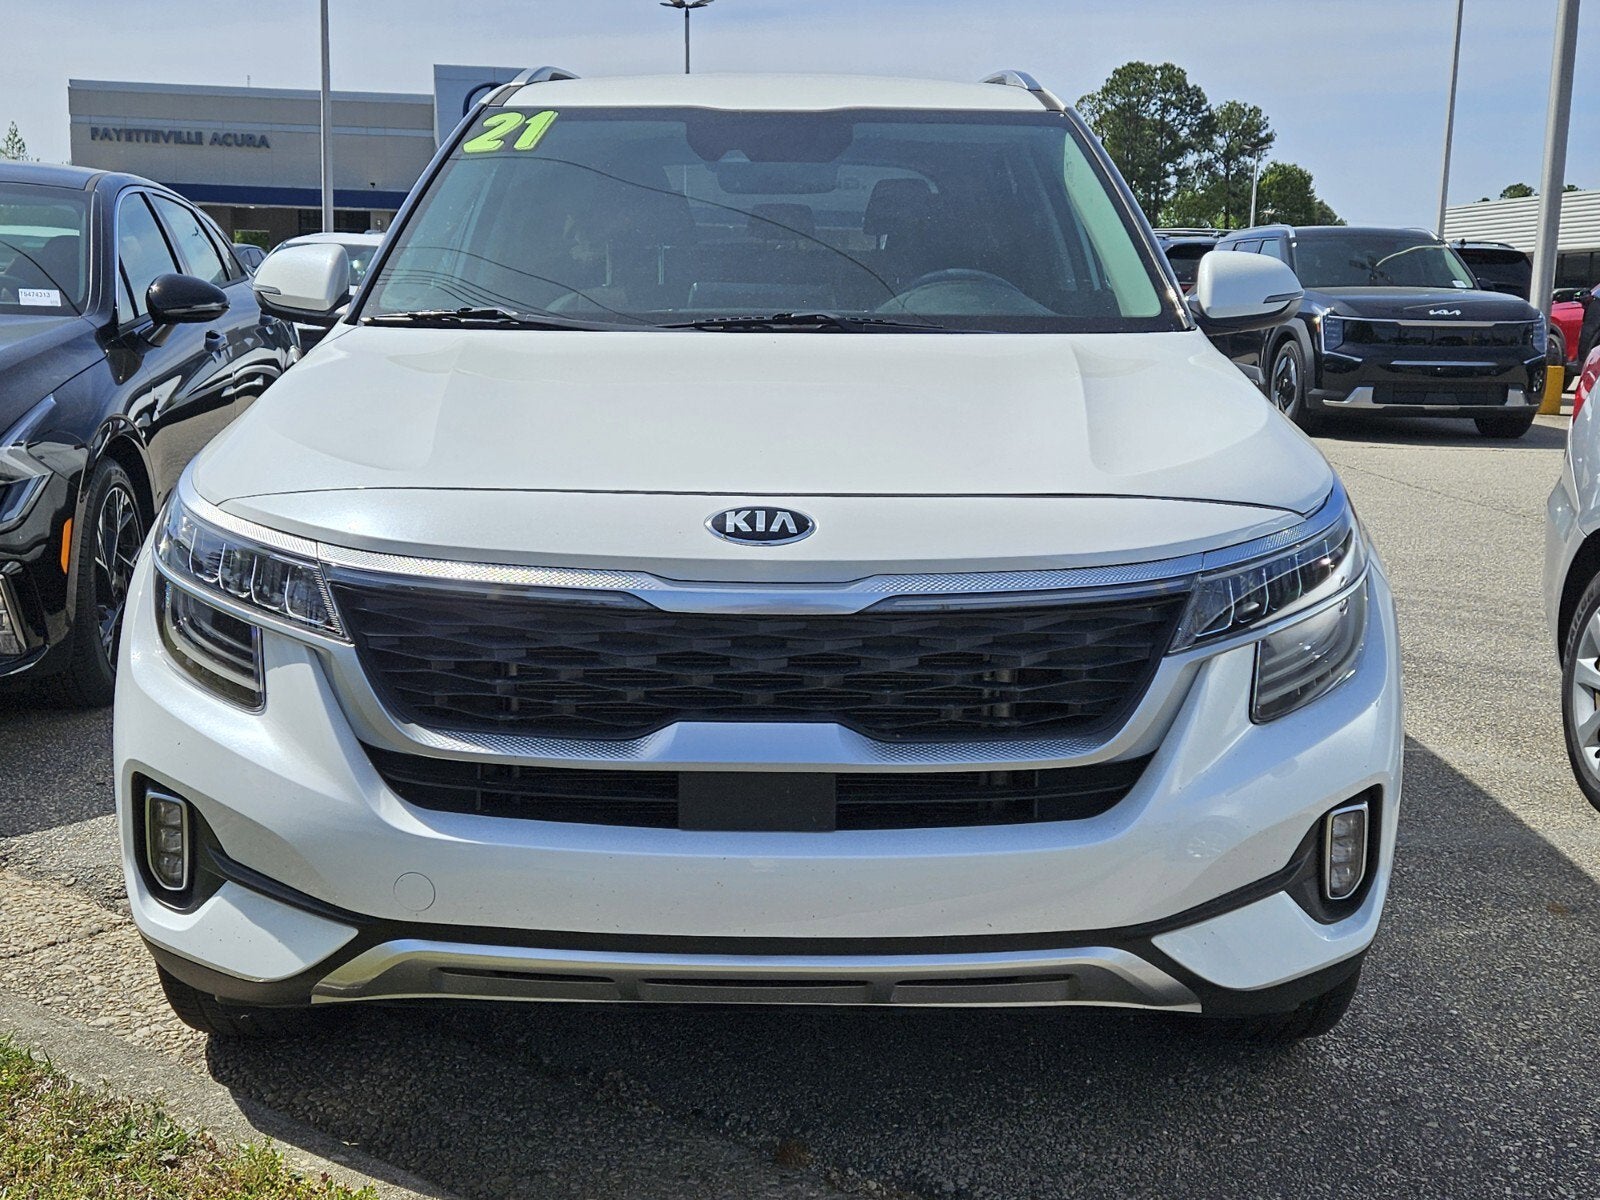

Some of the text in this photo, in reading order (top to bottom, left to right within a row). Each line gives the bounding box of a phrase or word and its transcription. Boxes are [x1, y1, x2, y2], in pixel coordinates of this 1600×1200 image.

[90, 127, 271, 149] FAYETTEVILLE ACURA
[463, 110, 558, 153] 21
[725, 510, 798, 534] KIA
